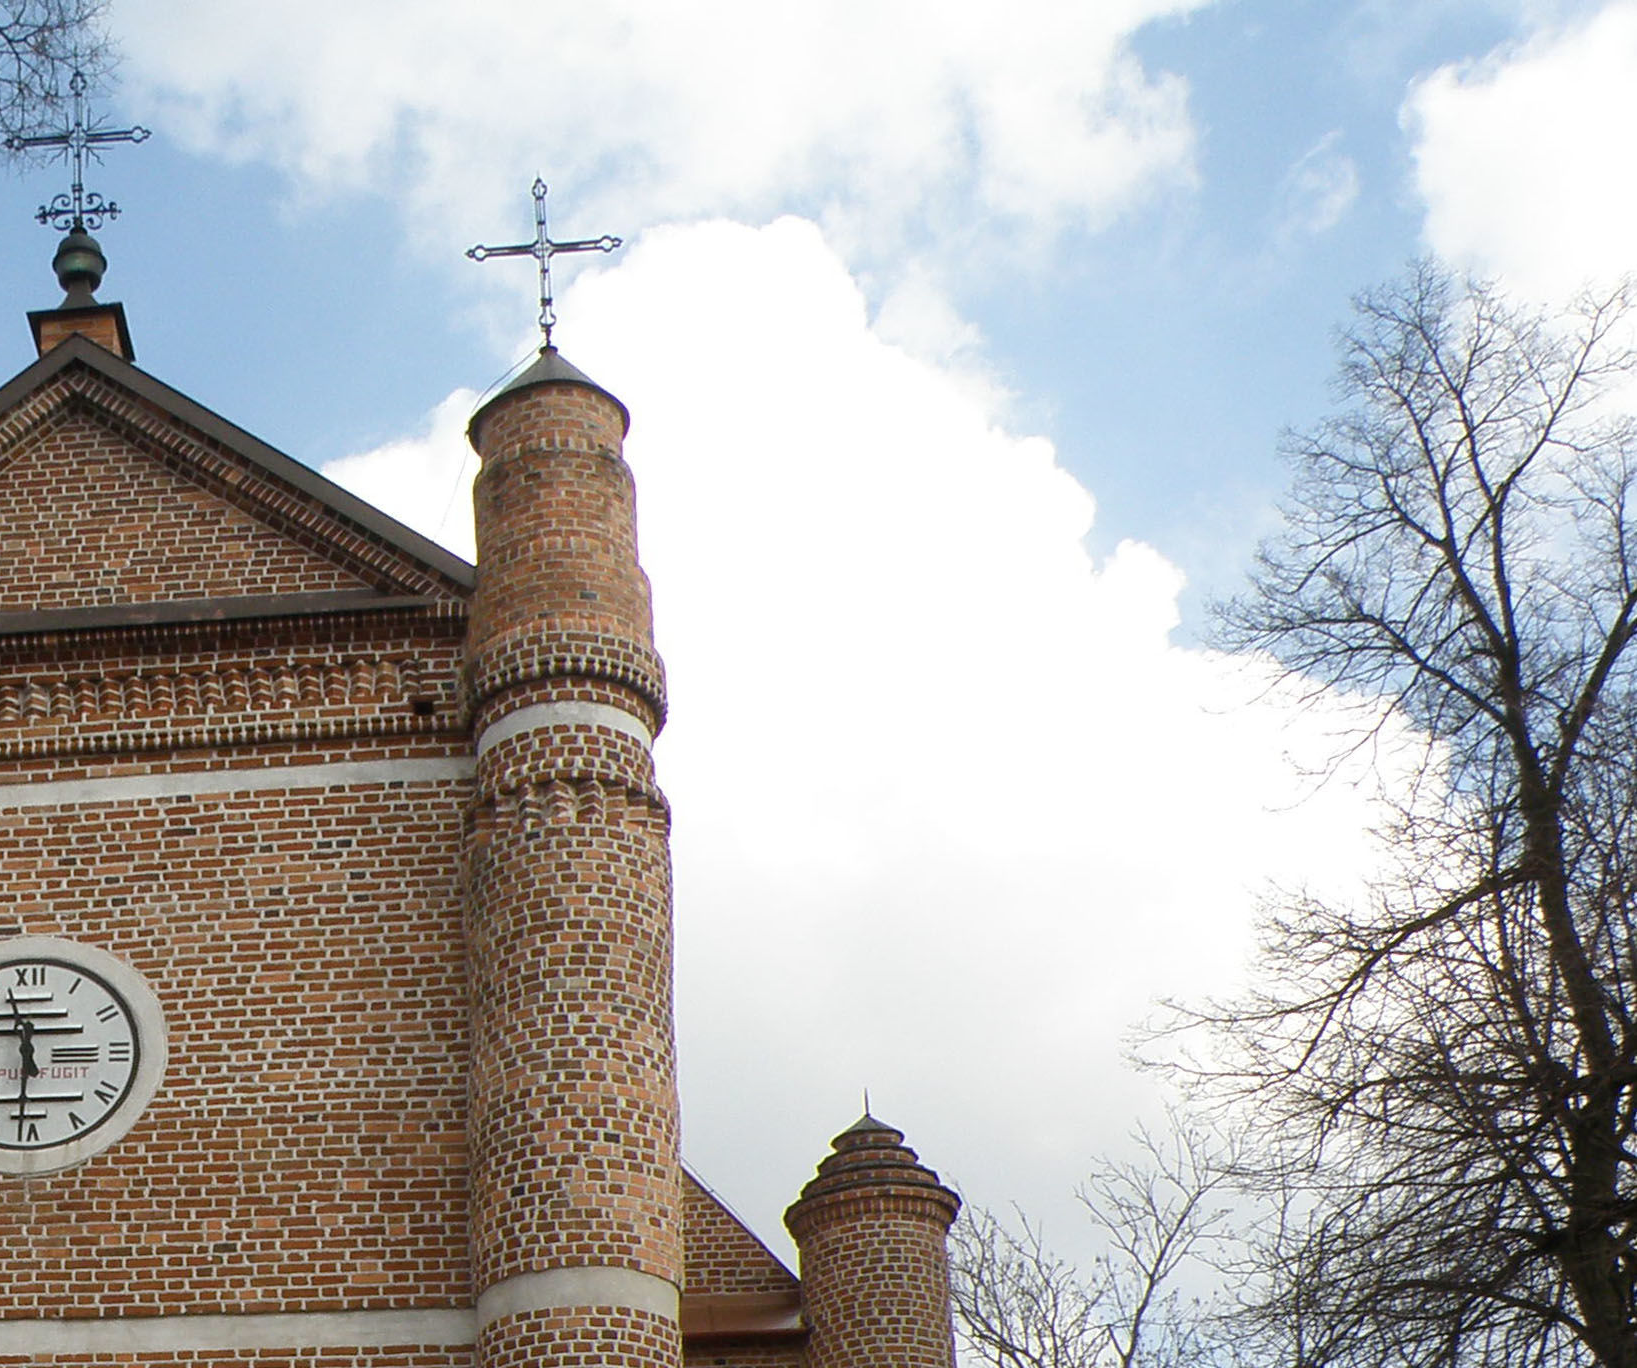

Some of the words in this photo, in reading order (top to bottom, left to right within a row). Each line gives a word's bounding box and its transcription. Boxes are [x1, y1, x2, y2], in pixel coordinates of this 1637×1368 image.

[15, 967, 46, 986] XII
[69, 978, 82, 994] I
[96, 1004, 119, 1023] II
[108, 1042, 130, 1062] III
[38, 1066, 90, 1080] FUGIT
[69, 1111, 86, 1130] V
